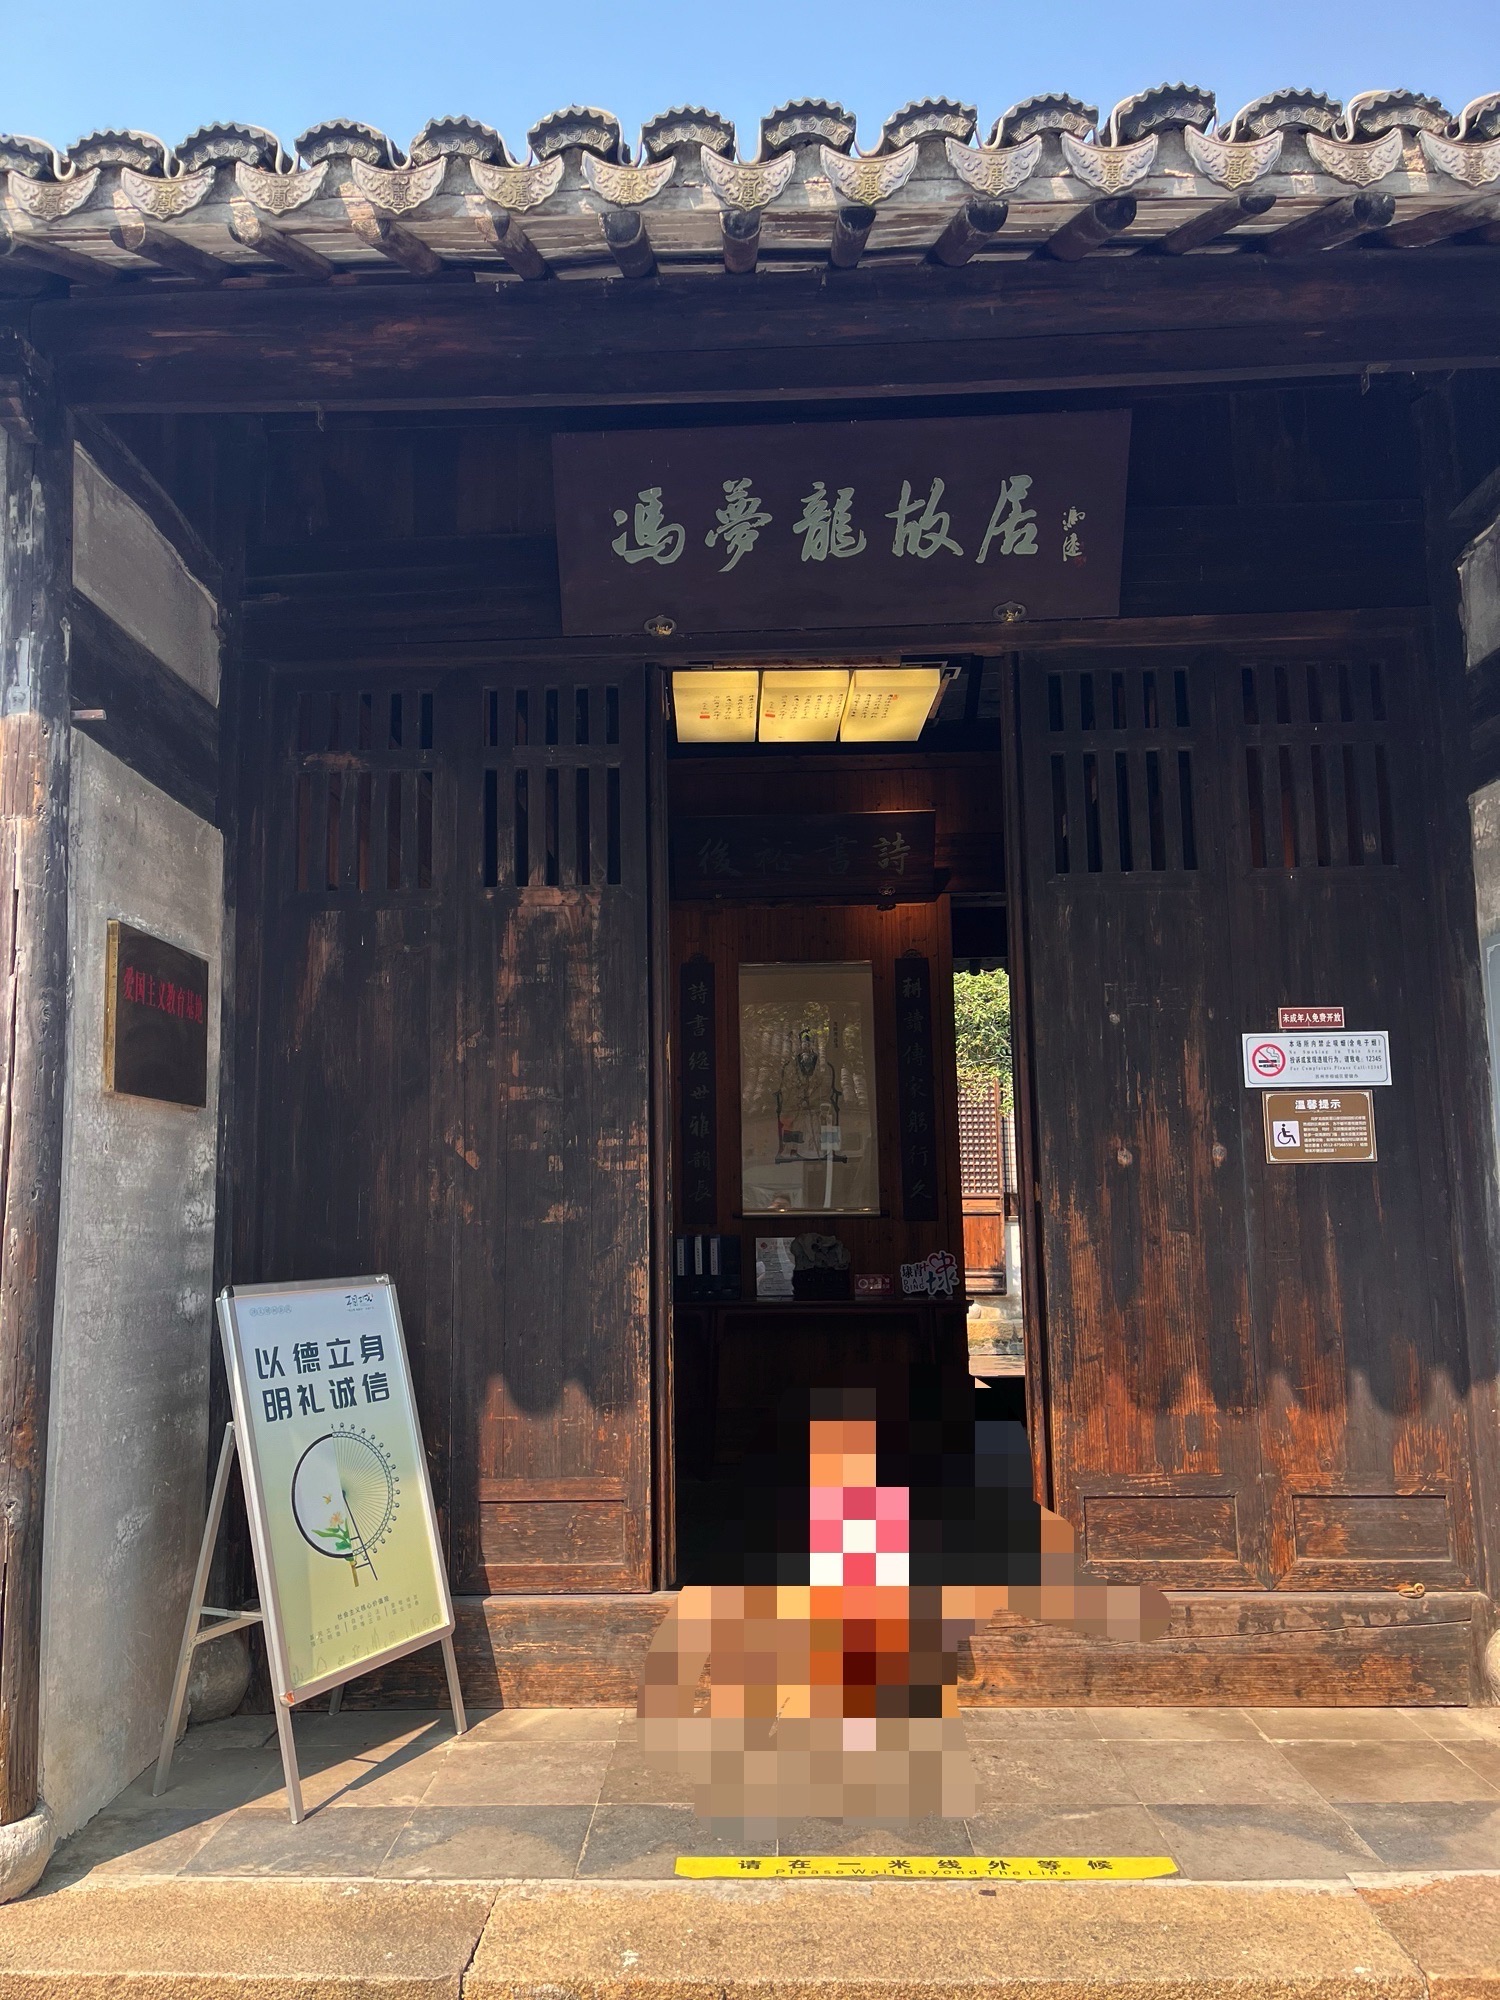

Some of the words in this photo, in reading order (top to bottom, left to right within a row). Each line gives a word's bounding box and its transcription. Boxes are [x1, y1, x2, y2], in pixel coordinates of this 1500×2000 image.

[123, 966, 204, 1024] 爱国主义教育基地
[1282, 1013, 1342, 1023] 未成年人免费开放
[1295, 1099, 1342, 1110] 温馨提示
[254, 1333, 386, 1381] 以德立身
[262, 1371, 391, 1424] 明礼诚信
[337, 1595, 390, 1621] 社会主义核心价值观
[738, 1859, 1113, 1870] 请在一米线外等候
[776, 1868, 844, 1876] Please
[852, 1868, 897, 1876] Wait
[904, 1868, 977, 1877] Beyond
